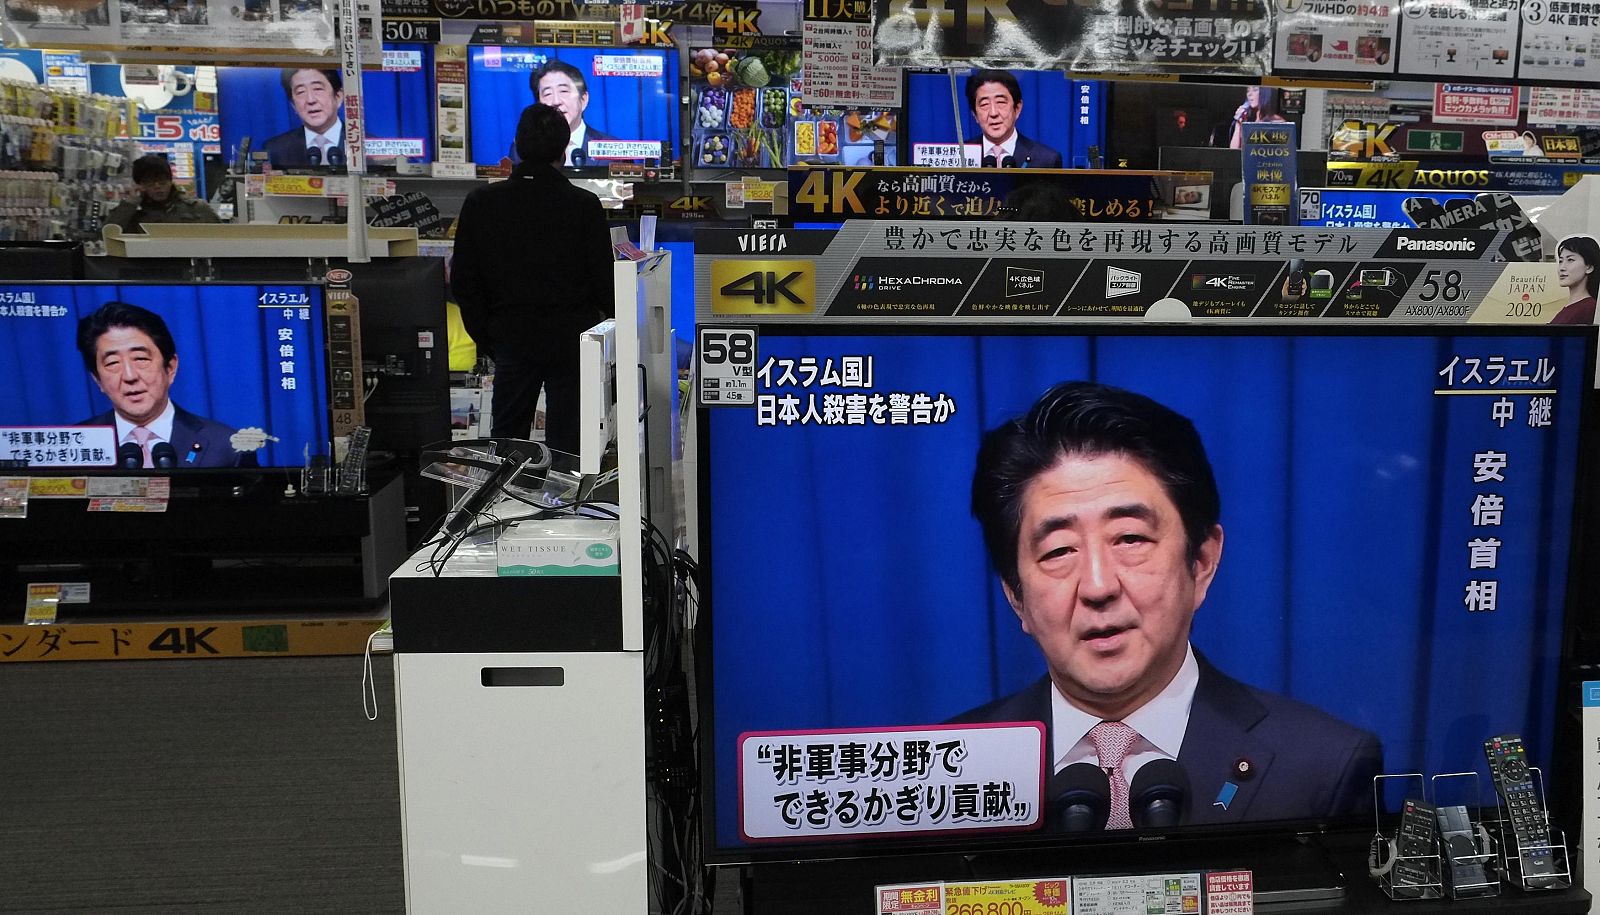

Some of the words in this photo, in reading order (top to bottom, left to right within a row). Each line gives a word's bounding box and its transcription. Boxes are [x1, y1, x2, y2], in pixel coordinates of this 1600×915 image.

[1529, 2, 1541, 21] 3
[713, 8, 761, 34] 4K
[386, 21, 428, 40] 50型
[1080, 85, 1091, 125] 安倍首相
[345, 95, 360, 167] 紙製メジャー
[1249, 131, 1270, 143] 4K
[1250, 148, 1290, 157] AQUOS
[1545, 139, 1578, 151] 日本製
[1256, 169, 1283, 181] 映像
[1366, 170, 1404, 189] 4K
[1414, 169, 1490, 187] AQUOS
[795, 170, 867, 214] 4K
[878, 174, 992, 194] なら高画質だから
[671, 197, 713, 210] 4K
[1301, 191, 1320, 205] 70
[1321, 203, 1378, 220] 「イスラム国」
[883, 225, 1358, 256] 豊かで忠実な色を再現する高画質モデル
[1396, 236, 1476, 252] Panasonic
[327, 270, 350, 279] NEW
[1009, 275, 1041, 283] 4K広色域
[1205, 277, 1227, 288] 4K
[1510, 275, 1547, 284] Beautiful
[720, 271, 806, 305] 4K
[1508, 283, 1546, 294] JAPAN
[259, 292, 310, 305] イスラエル
[1404, 305, 1471, 317] AX800/AX800F
[1505, 301, 1543, 319] 2020
[703, 332, 753, 365] 58
[278, 327, 297, 390] 安倍首相
[732, 366, 753, 377] V型
[756, 355, 874, 389] イスラム国」
[1438, 355, 1556, 387] イスラエル
[756, 393, 957, 426] 日本人殺害を警告か
[335, 413, 352, 424] 48
[1, 430, 83, 447] “非軍事分野で
[1464, 450, 1508, 613] 安倍首相
[148, 627, 219, 655] 4K
[756, 739, 966, 782] “非軍事分野で
[900, 888, 938, 904] 無金利
[882, 900, 899, 910] 限定
